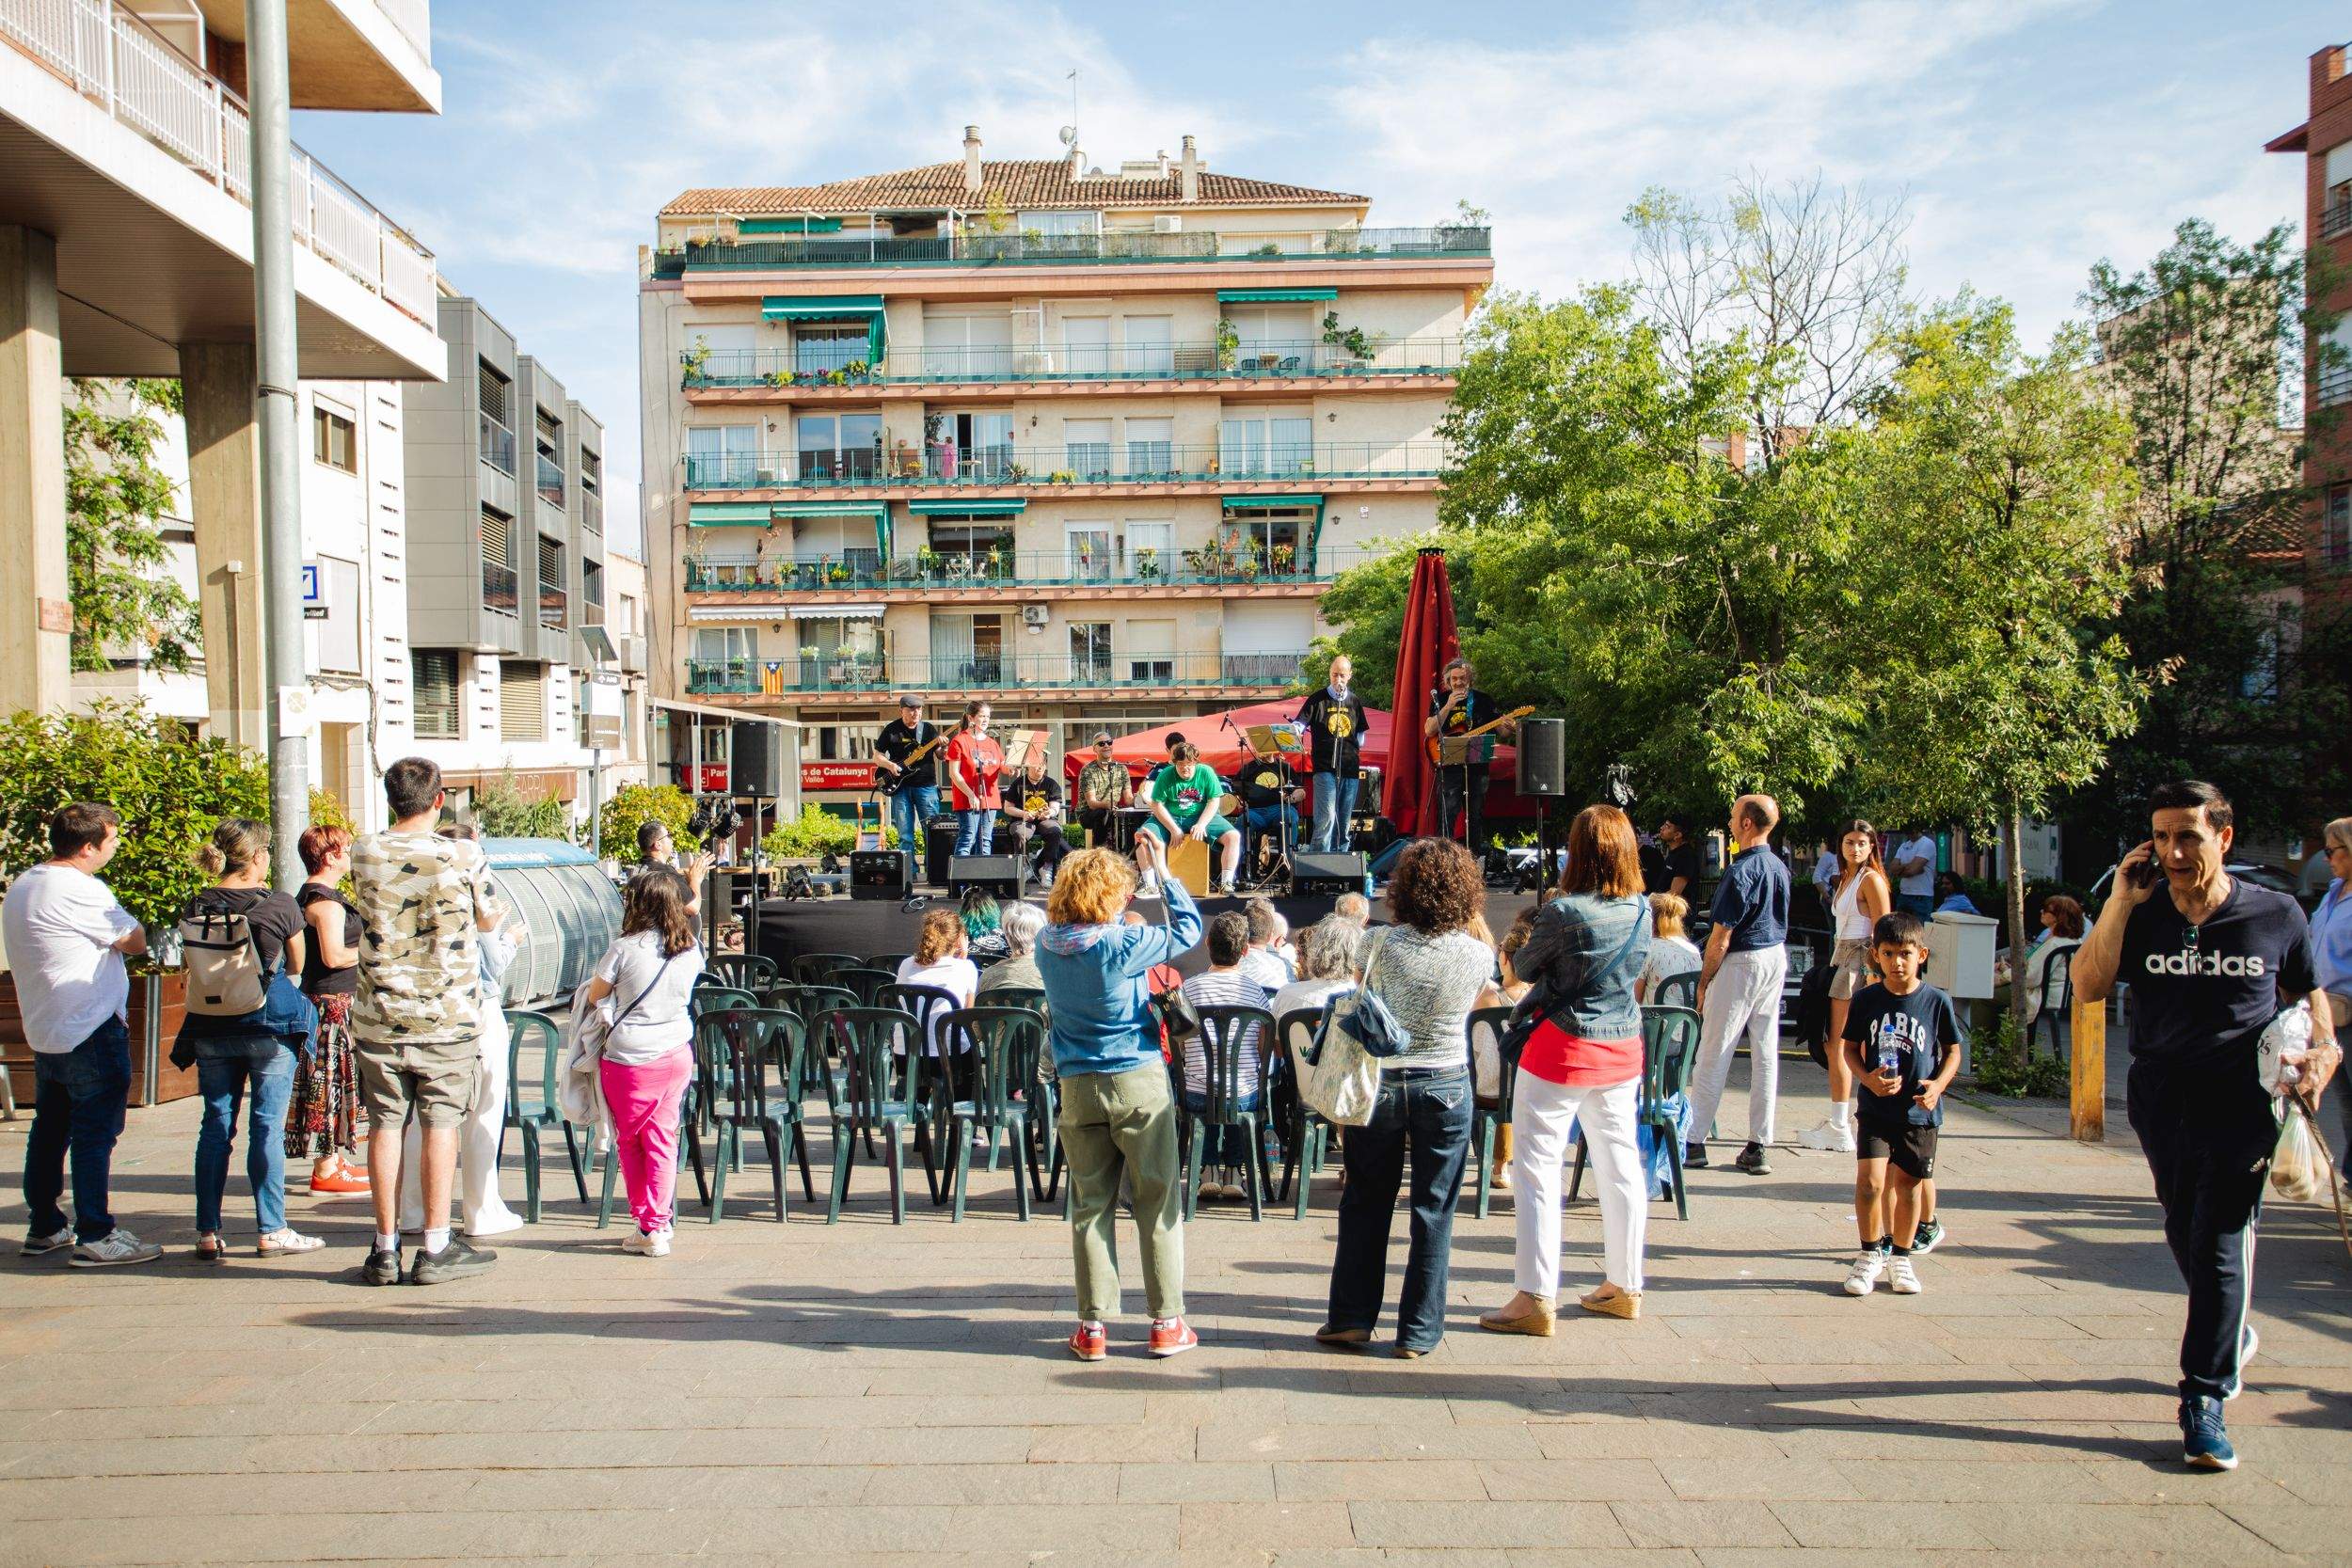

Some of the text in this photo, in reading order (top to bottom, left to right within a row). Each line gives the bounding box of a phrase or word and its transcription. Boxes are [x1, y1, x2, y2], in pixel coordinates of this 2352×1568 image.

[810, 768, 821, 776] de
[823, 767, 868, 778] Catalunya
[2145, 949, 2265, 976] adidas
[1869, 1012, 1926, 1053] PARIS
